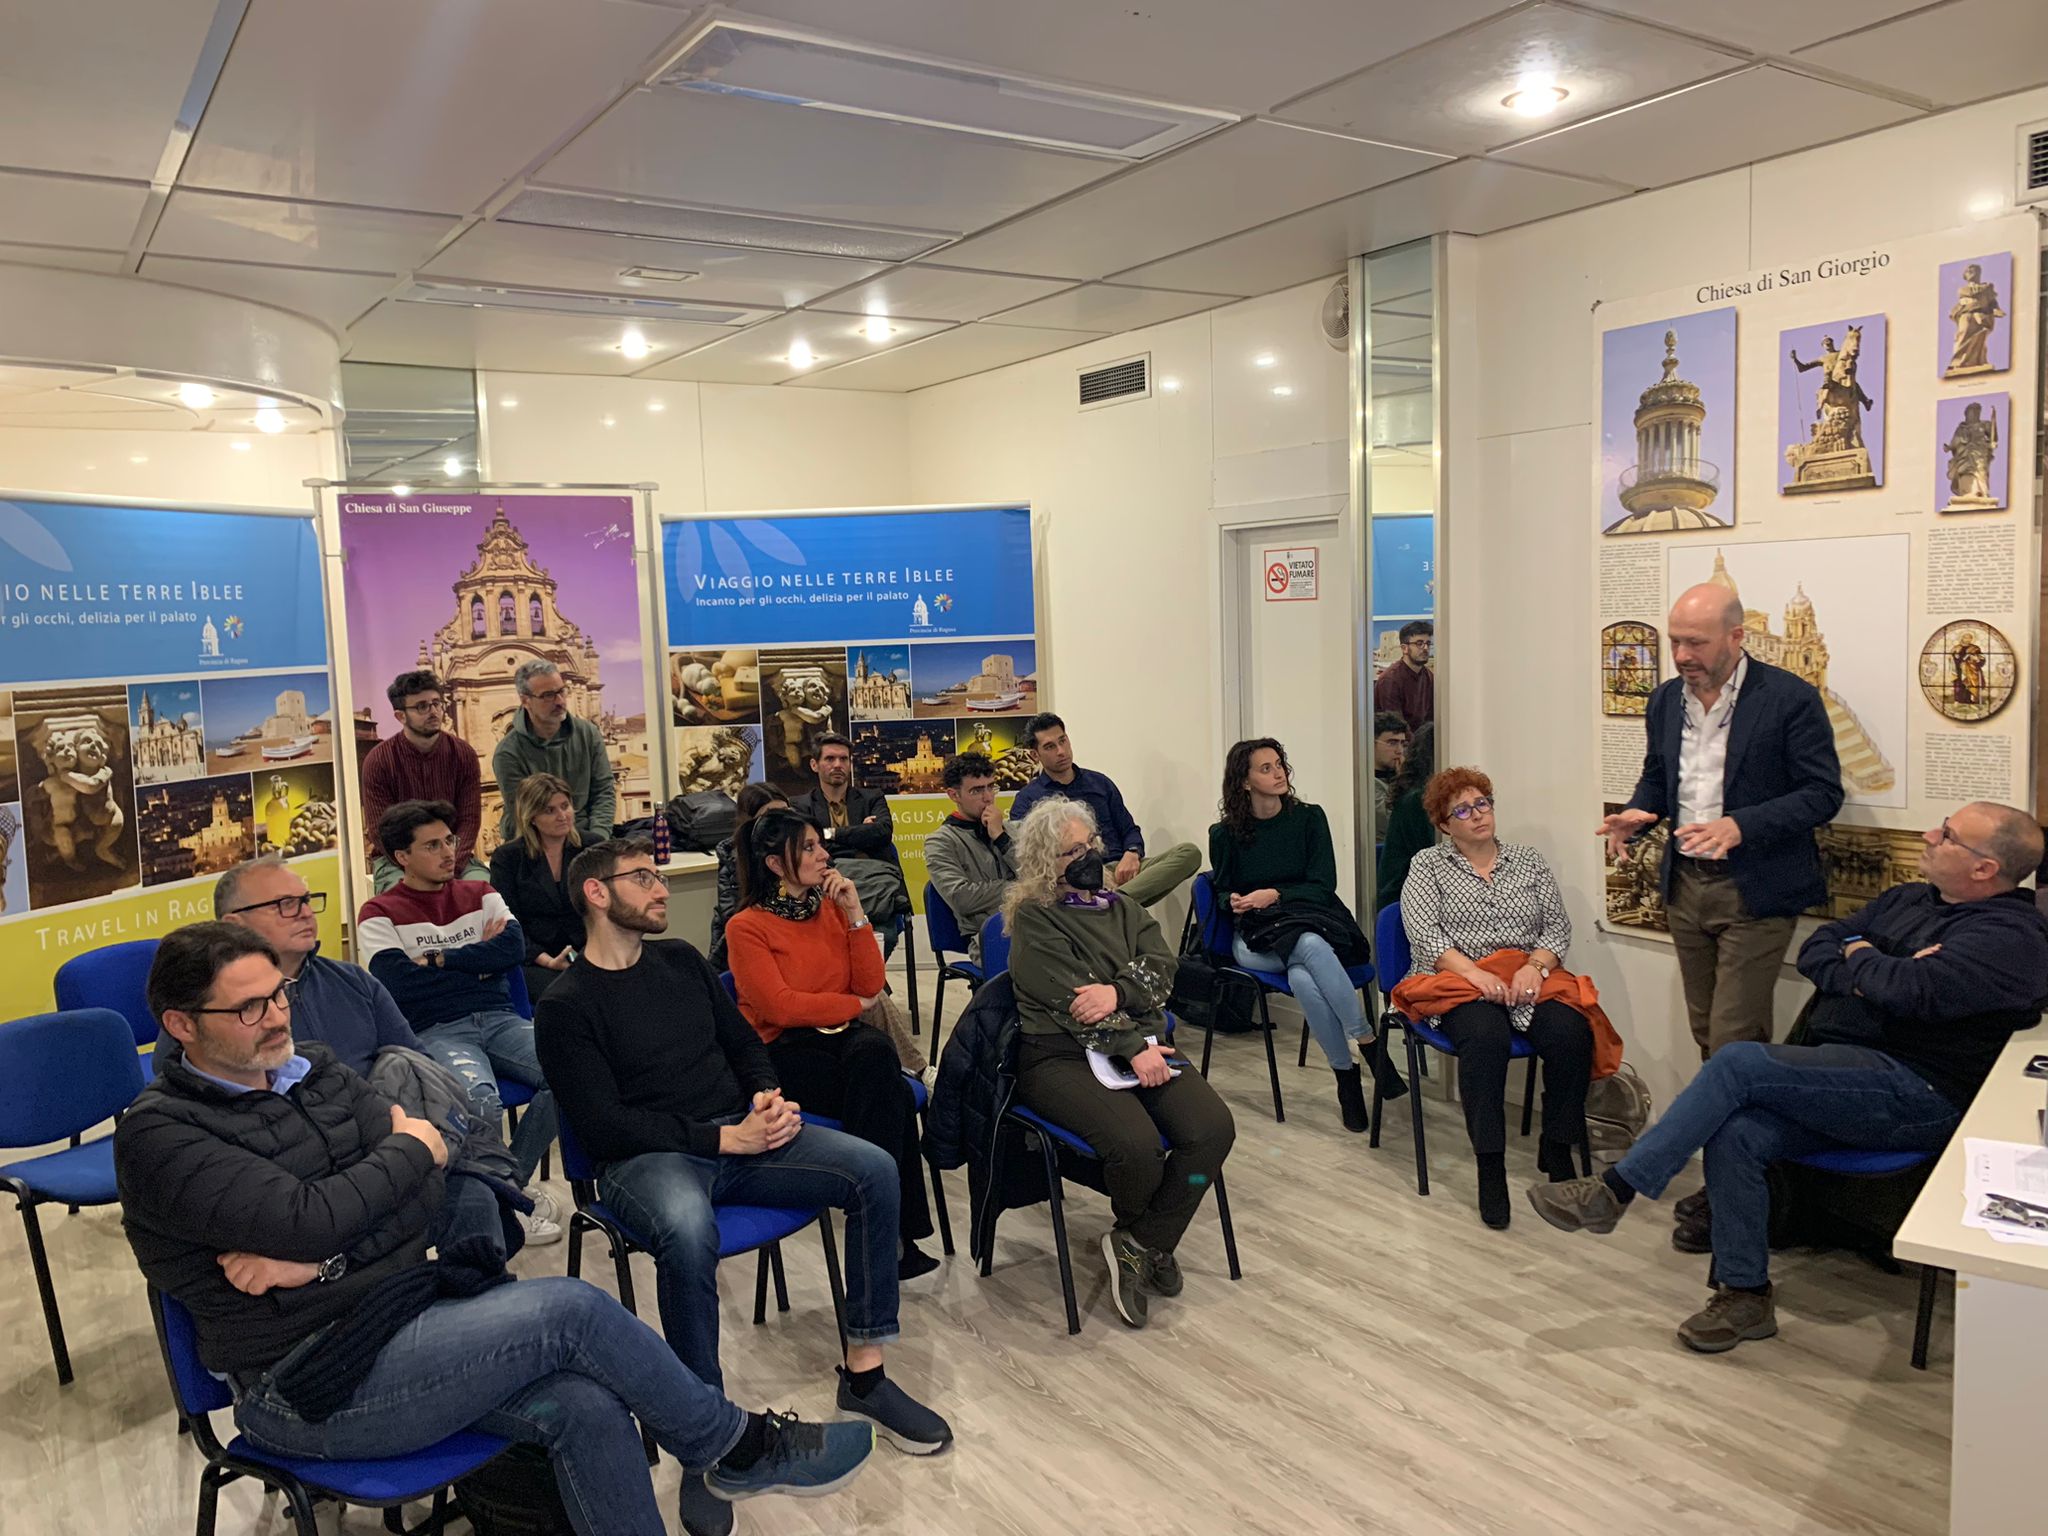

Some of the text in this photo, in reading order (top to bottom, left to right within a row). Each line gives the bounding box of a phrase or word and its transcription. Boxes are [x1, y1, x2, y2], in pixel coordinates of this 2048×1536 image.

[1696, 250, 1890, 304] Chiesa di San Giorgio
[345, 502, 472, 516] Chiesa di San Giuseppe
[1289, 560, 1315, 570] VIETATO
[1289, 569, 1315, 579] FUMARE
[694, 567, 954, 590] VIAGGIO NELLE TERRE IBLEE
[40, 584, 110, 601] NELLE
[119, 584, 183, 601] TERRE
[192, 580, 244, 601] IBLEE
[696, 590, 909, 608] Incanto per gli occhi, delizia per il palato
[11, 611, 29, 629] gli
[34, 611, 74, 626] occhi,
[79, 611, 121, 625] delizia
[125, 613, 145, 626] per
[149, 611, 156, 624] il
[161, 610, 197, 625] palato
[891, 810, 946, 824] AGUSA
[35, 897, 209, 950] TRAVEL IN RAG
[416, 927, 476, 946] PULL&BEAR
